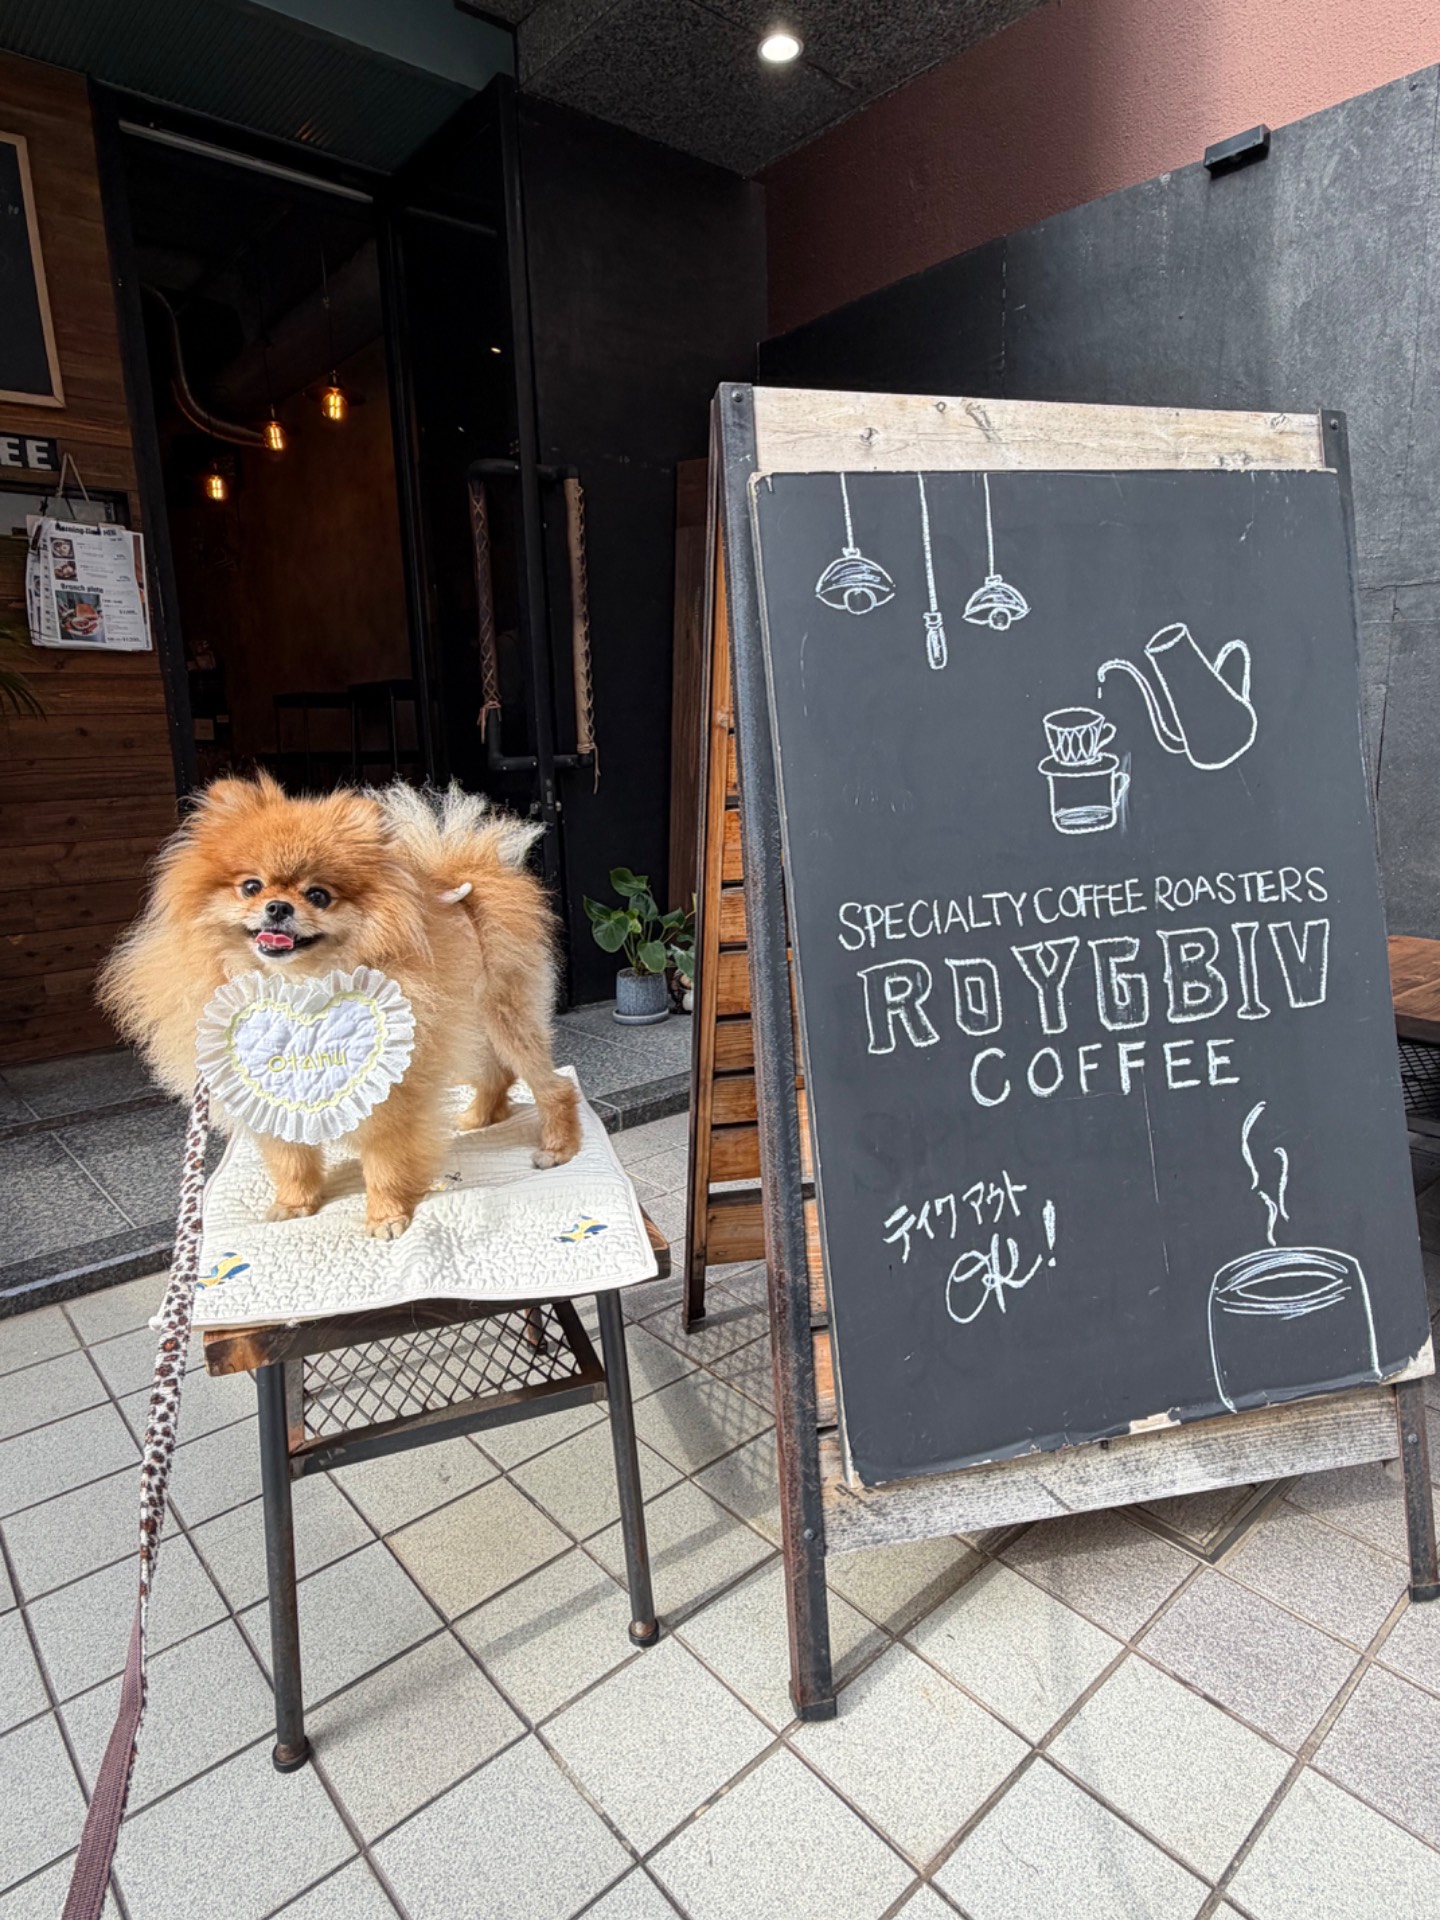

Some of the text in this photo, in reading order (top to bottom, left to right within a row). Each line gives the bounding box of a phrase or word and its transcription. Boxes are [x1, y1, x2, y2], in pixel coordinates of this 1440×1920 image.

[838, 867, 1328, 951] SPECIALTY COFFEE ROASTERS
[857, 918, 1331, 1055] ROYGBIV
[970, 1038, 1240, 1107] COFFEE
